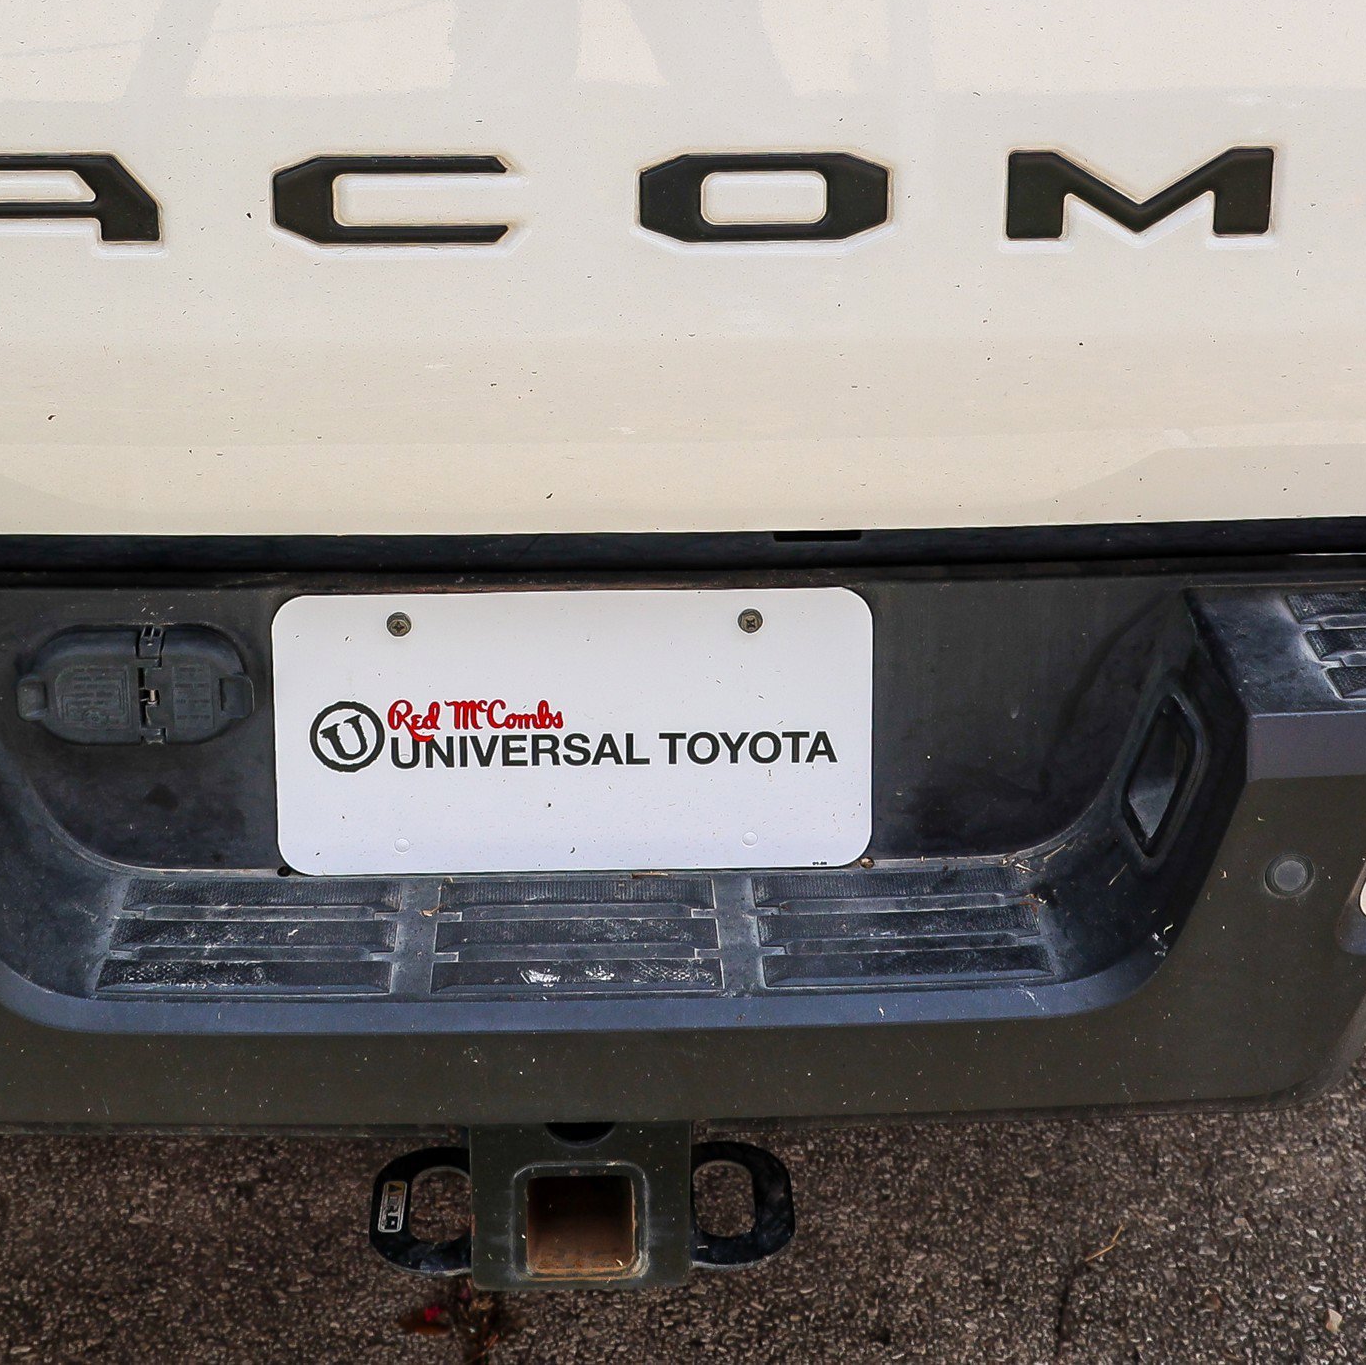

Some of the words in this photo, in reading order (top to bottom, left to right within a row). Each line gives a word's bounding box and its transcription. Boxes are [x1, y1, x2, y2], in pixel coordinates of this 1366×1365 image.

[387, 699, 444, 743] Red
[390, 733, 650, 769] UNIVERSAL
[658, 731, 838, 766] TOYOTA
